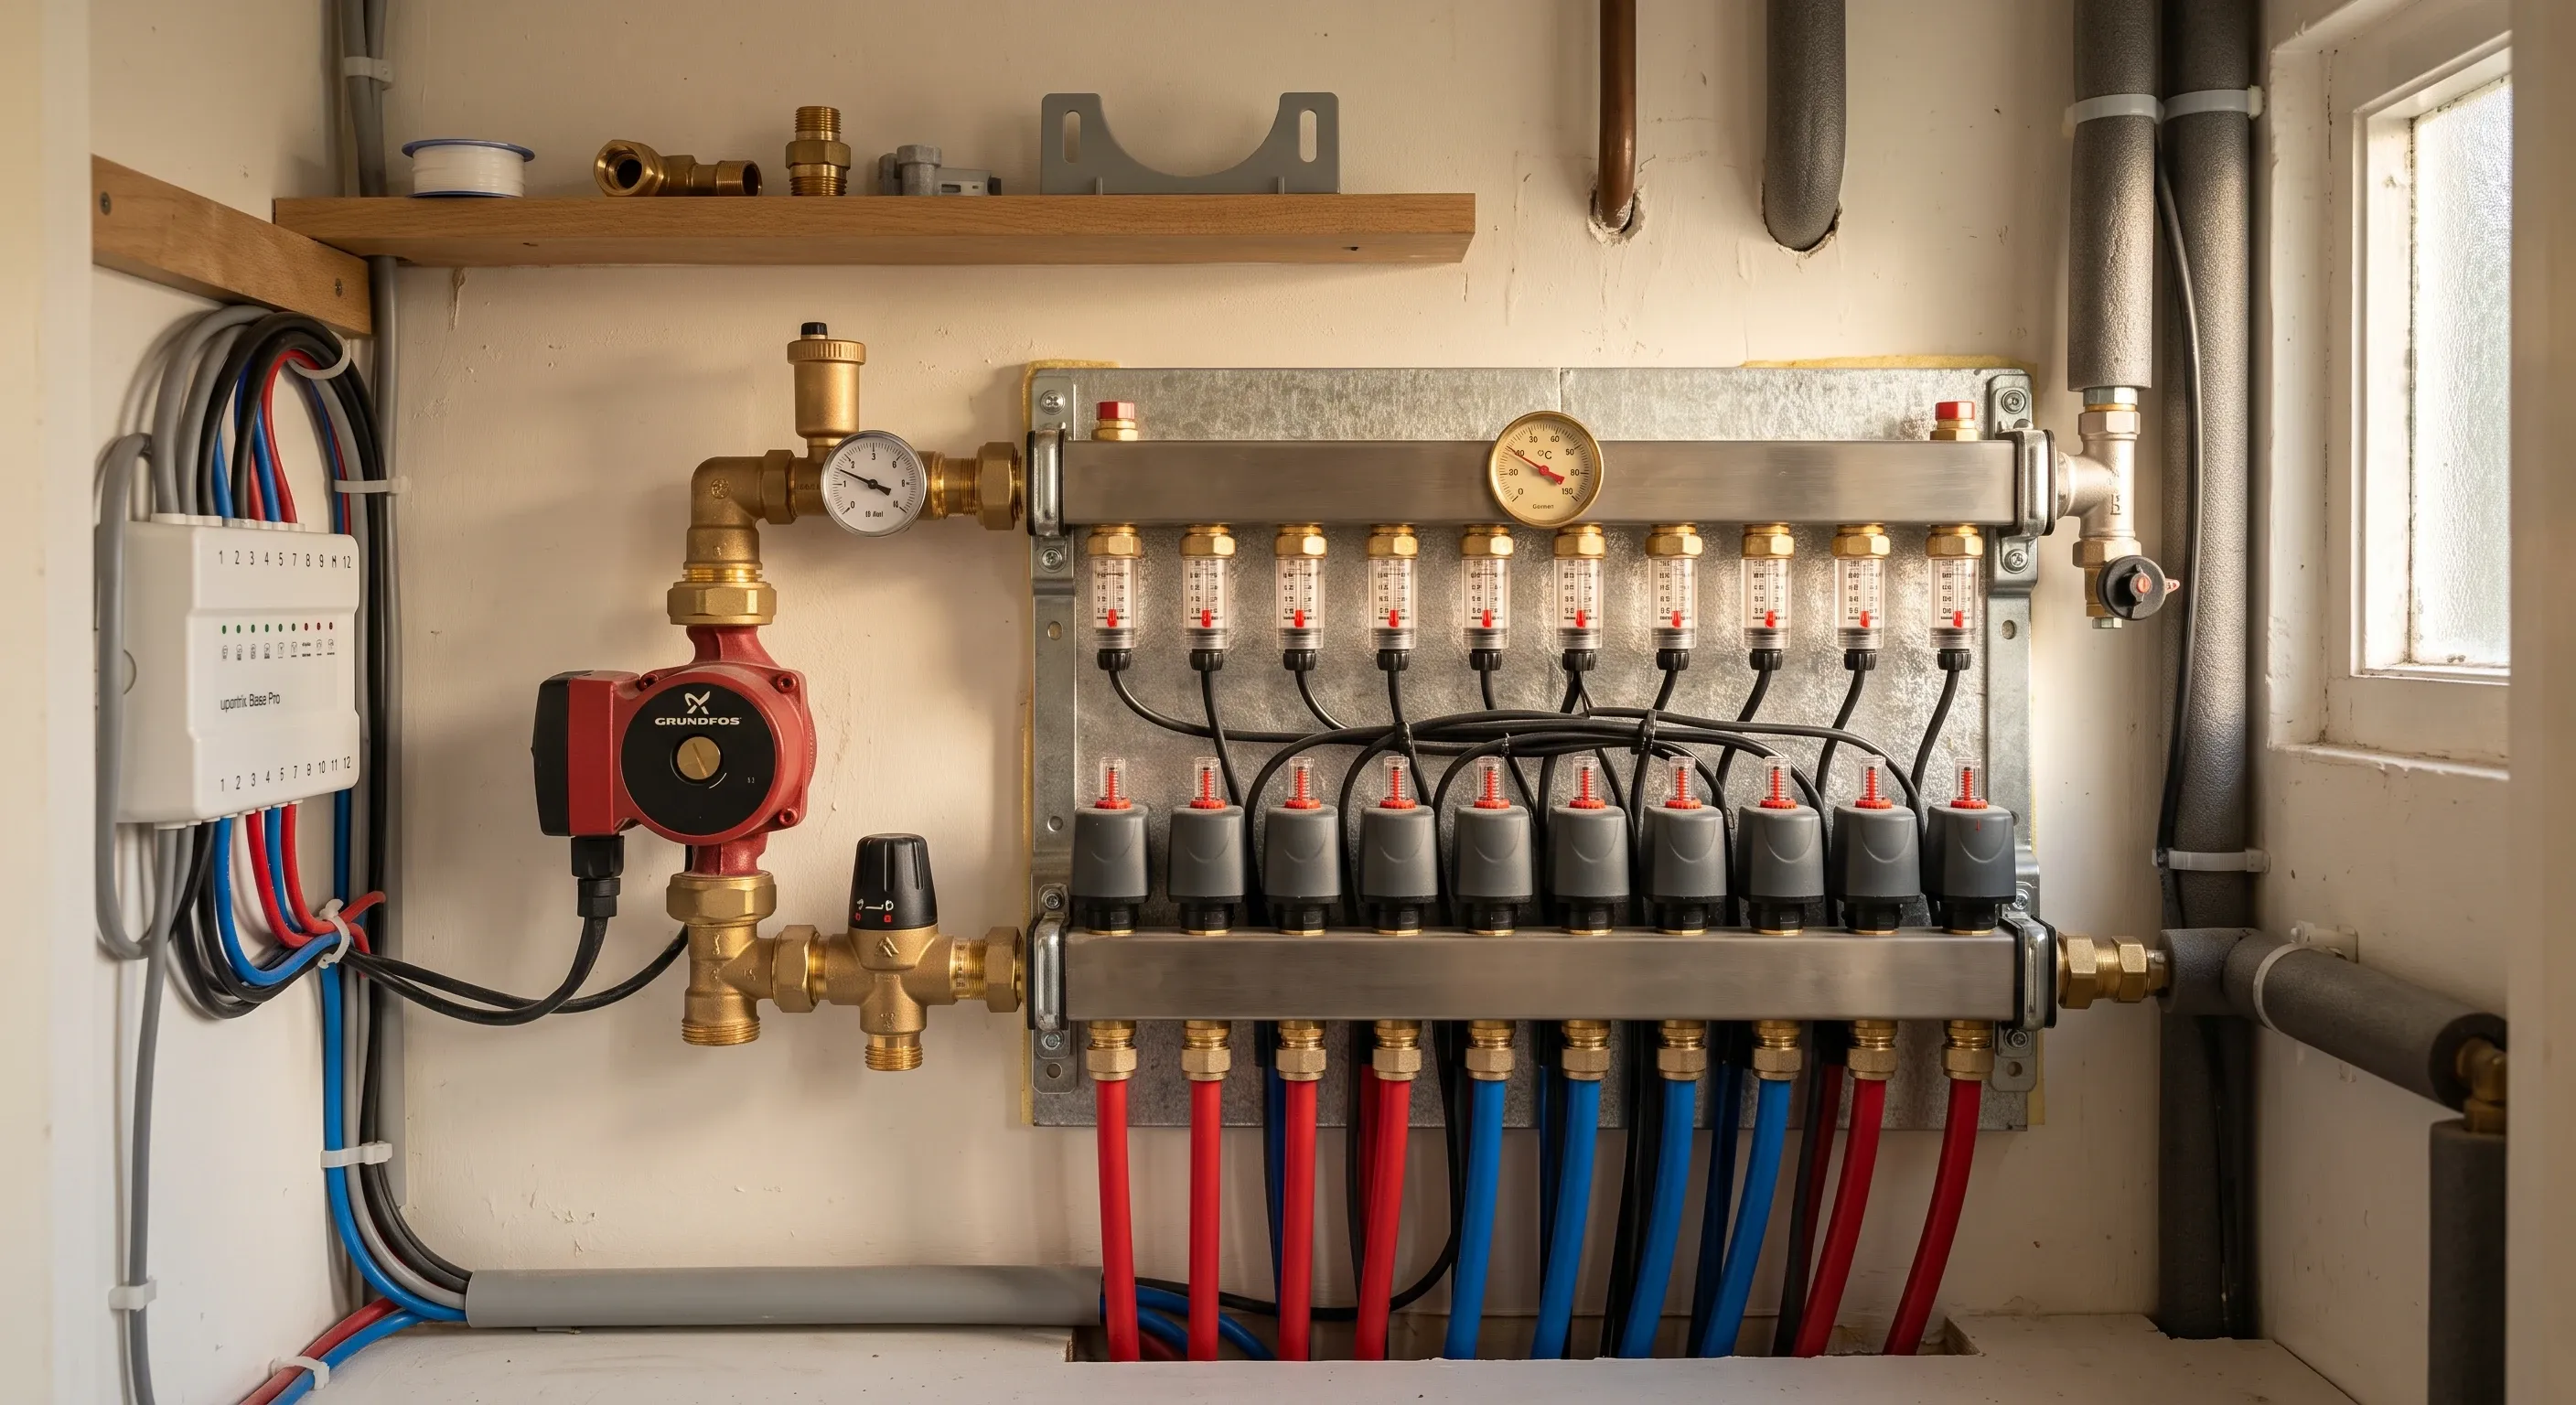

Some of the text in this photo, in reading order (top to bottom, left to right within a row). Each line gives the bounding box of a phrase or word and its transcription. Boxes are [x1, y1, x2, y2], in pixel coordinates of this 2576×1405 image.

[871, 452, 876, 460] 3
[850, 500, 855, 509] 0
[234, 550, 240, 565] 2
[250, 551, 254, 565] 3
[264, 552, 270, 566] 4
[278, 552, 284, 566] 5
[292, 553, 297, 566] 7
[306, 553, 311, 567] 8
[319, 554, 324, 567] 9
[343, 556, 351, 569] 12
[249, 692, 267, 707] Base
[268, 691, 281, 705] Pro
[654, 716, 740, 726] GRUNDFOS
[235, 776, 241, 790] 2
[251, 773, 256, 787] 3
[265, 770, 271, 783] 4
[294, 765, 298, 778] 7
[318, 760, 326, 773] 10
[331, 758, 338, 771] 11
[343, 756, 351, 768] 12
